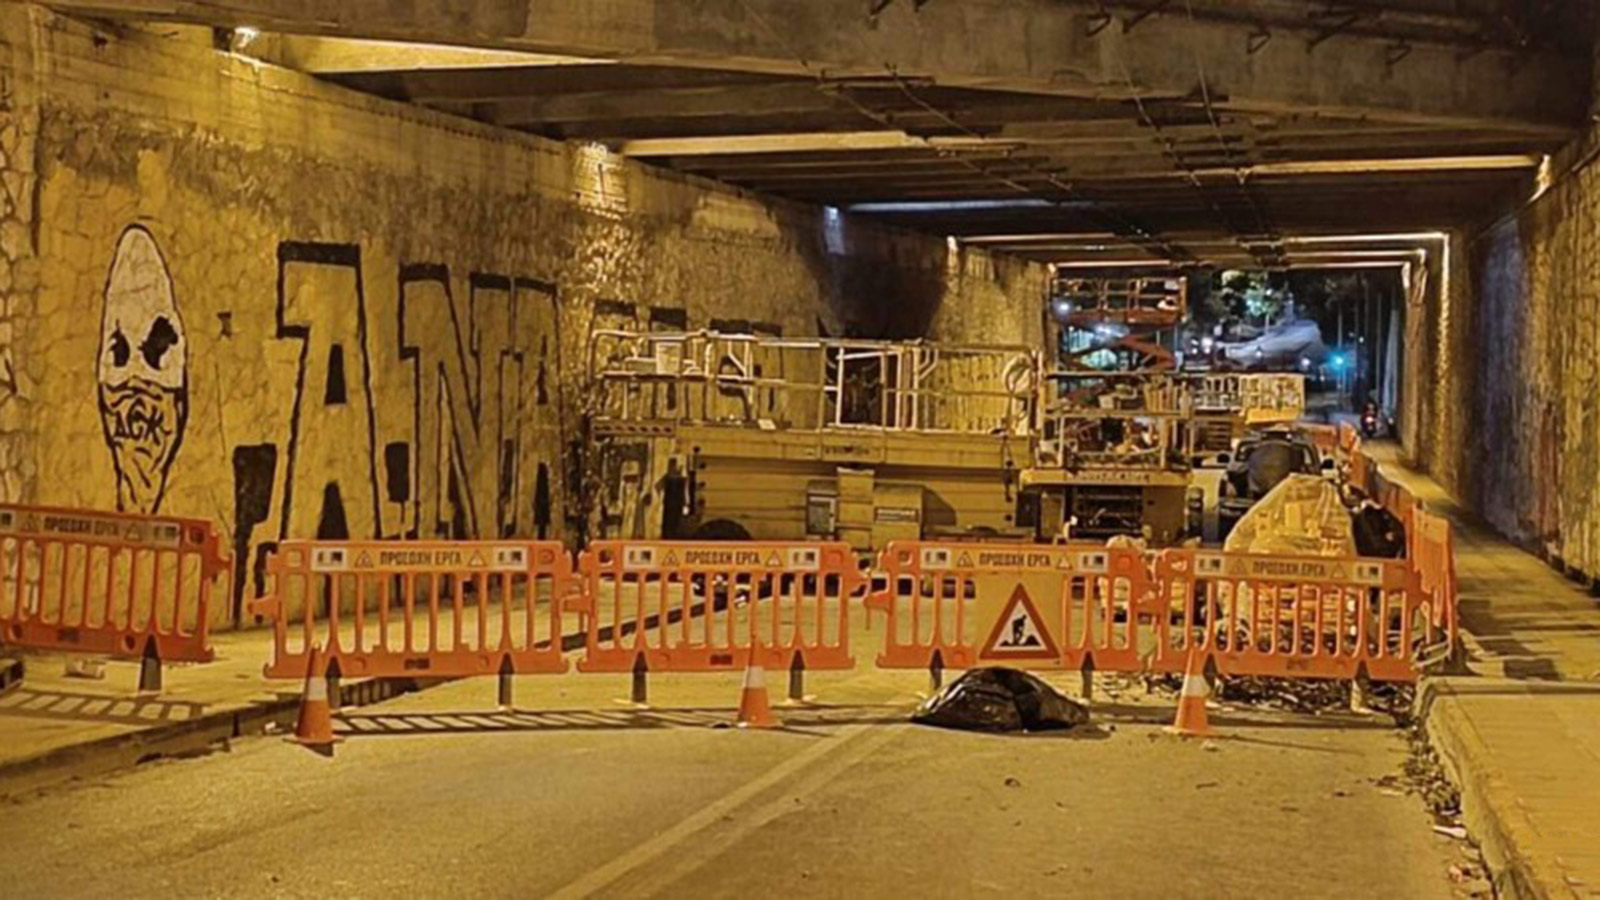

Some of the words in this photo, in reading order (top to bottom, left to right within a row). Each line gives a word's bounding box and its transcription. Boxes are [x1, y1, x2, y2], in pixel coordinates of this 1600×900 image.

[380, 551, 431, 566] ΠΡΟΣΟΧΗ
[435, 551, 461, 566] ΕΡΓΑ
[685, 551, 732, 565] ΠΡΟΣΟΧΗ
[735, 551, 760, 565] ΕΡΓΑ
[1027, 553, 1051, 567] ΕΡΓΑ
